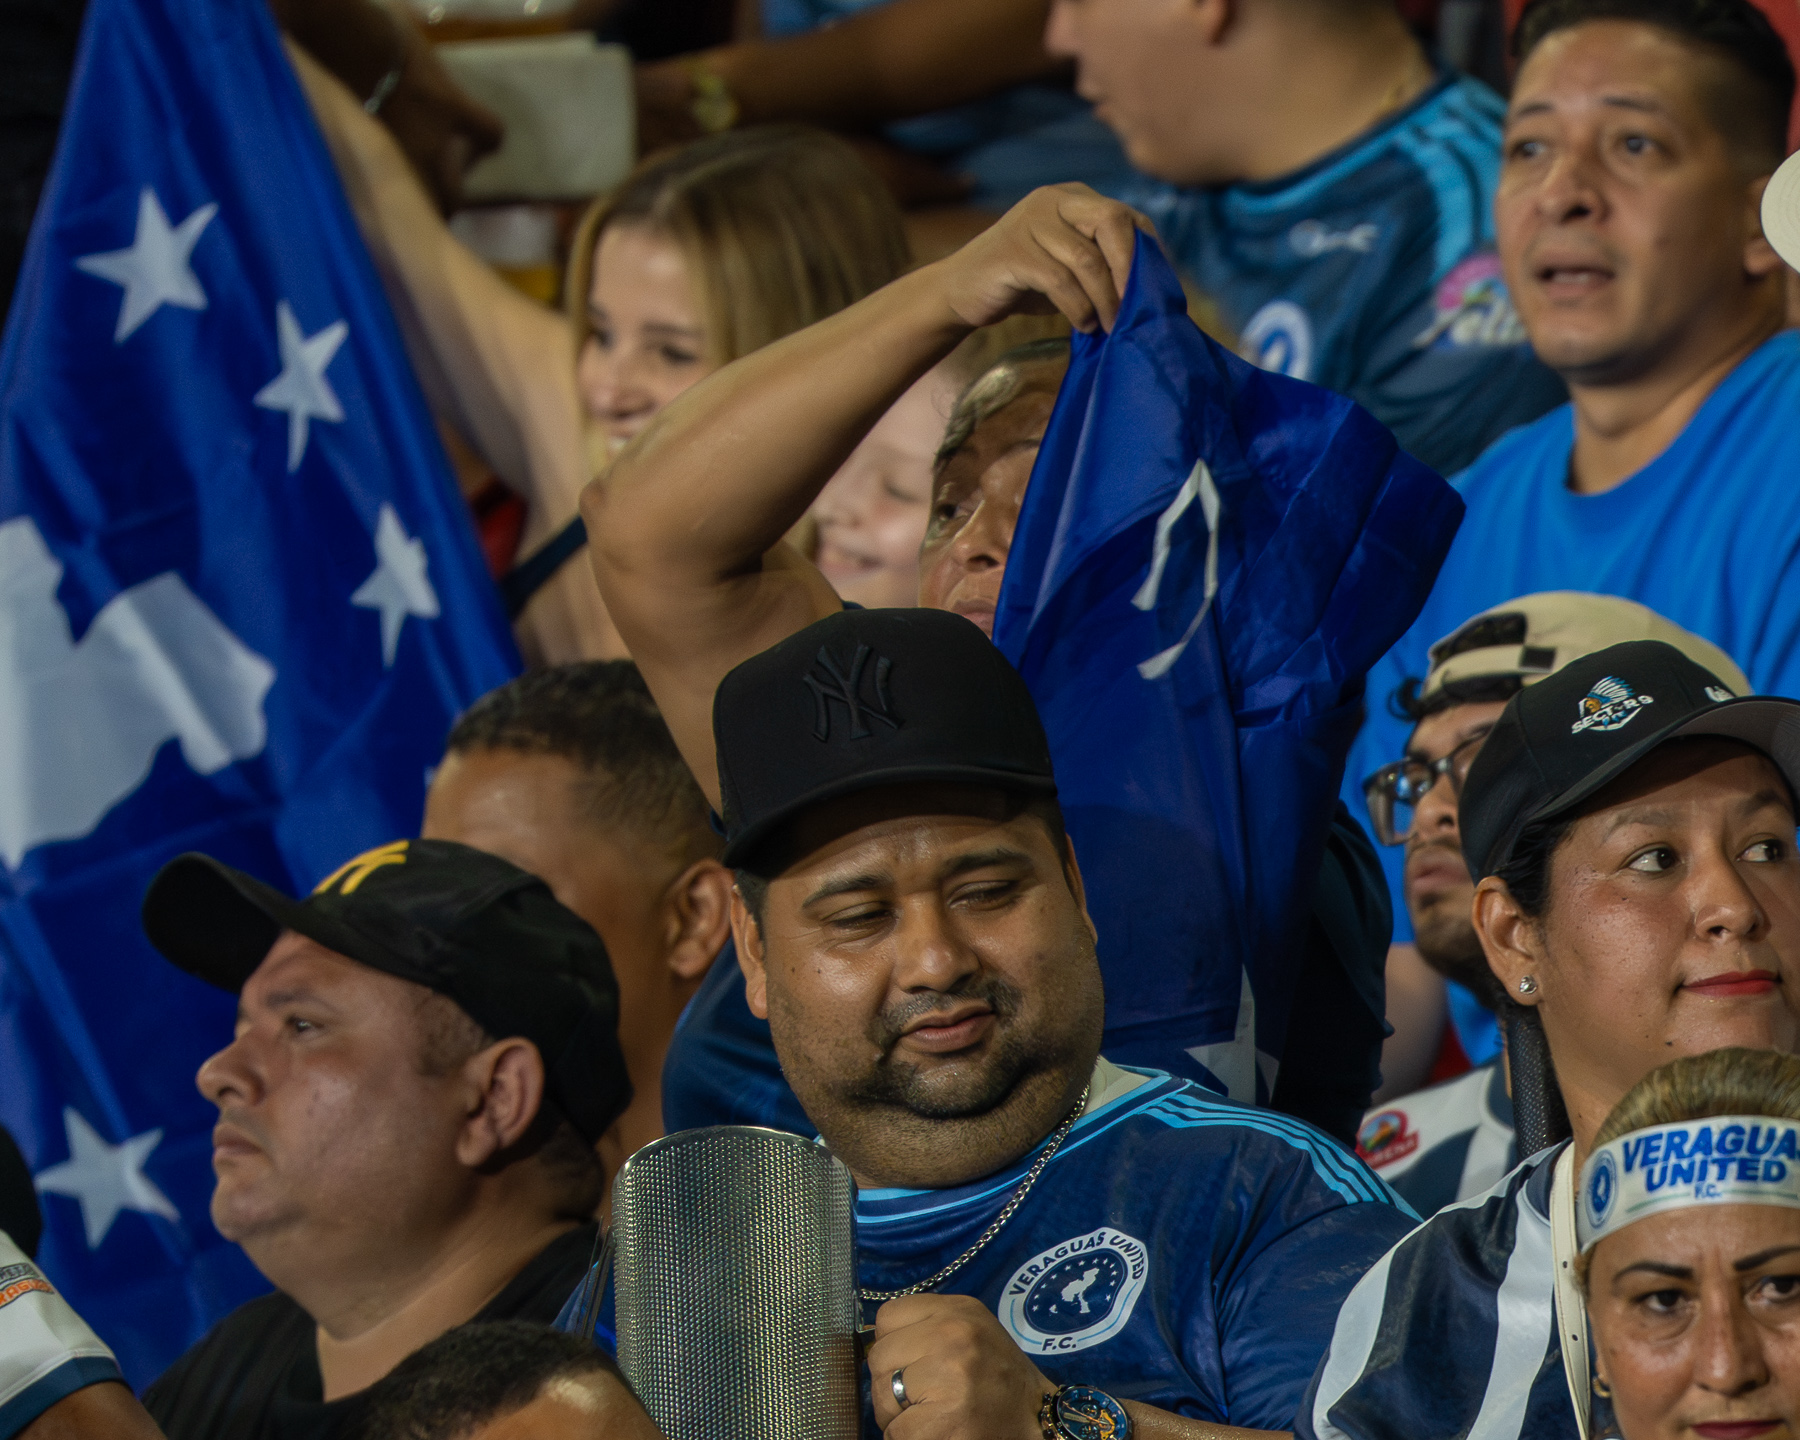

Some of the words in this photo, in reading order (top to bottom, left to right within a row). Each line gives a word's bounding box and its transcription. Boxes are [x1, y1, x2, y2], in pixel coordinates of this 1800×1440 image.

[1646, 1157, 1787, 1192] UNITED
[1009, 1231, 1106, 1295] VERAGUAS
[1109, 1235, 1145, 1280] UNITED
[1042, 1336, 1077, 1351] F.C.
